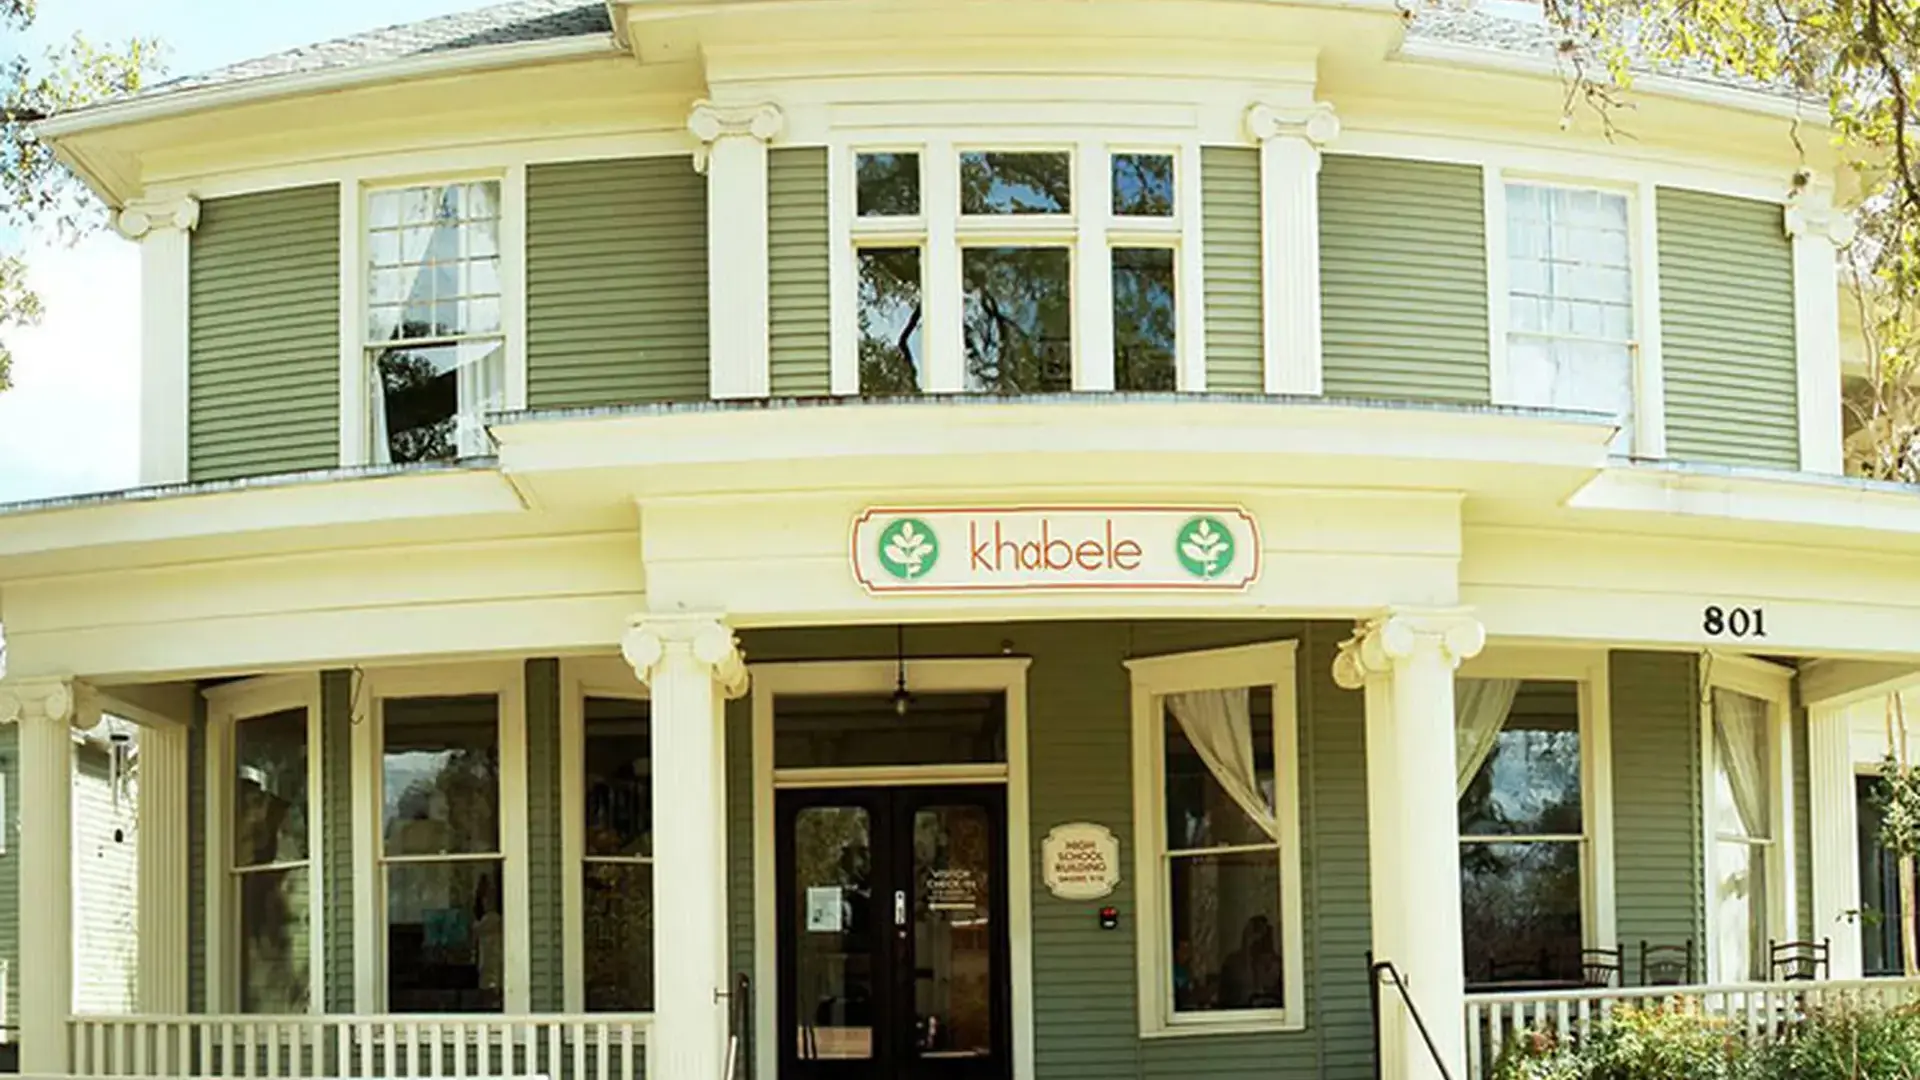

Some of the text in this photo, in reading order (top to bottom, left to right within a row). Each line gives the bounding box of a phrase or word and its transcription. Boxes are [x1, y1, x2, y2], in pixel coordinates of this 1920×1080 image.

[970, 519, 1142, 571] khabele
[1703, 605, 1767, 637] 801
[1065, 840, 1096, 850] HIGH
[1057, 851, 1104, 861] SCHOOL
[1055, 862, 1107, 873] BUILDING
